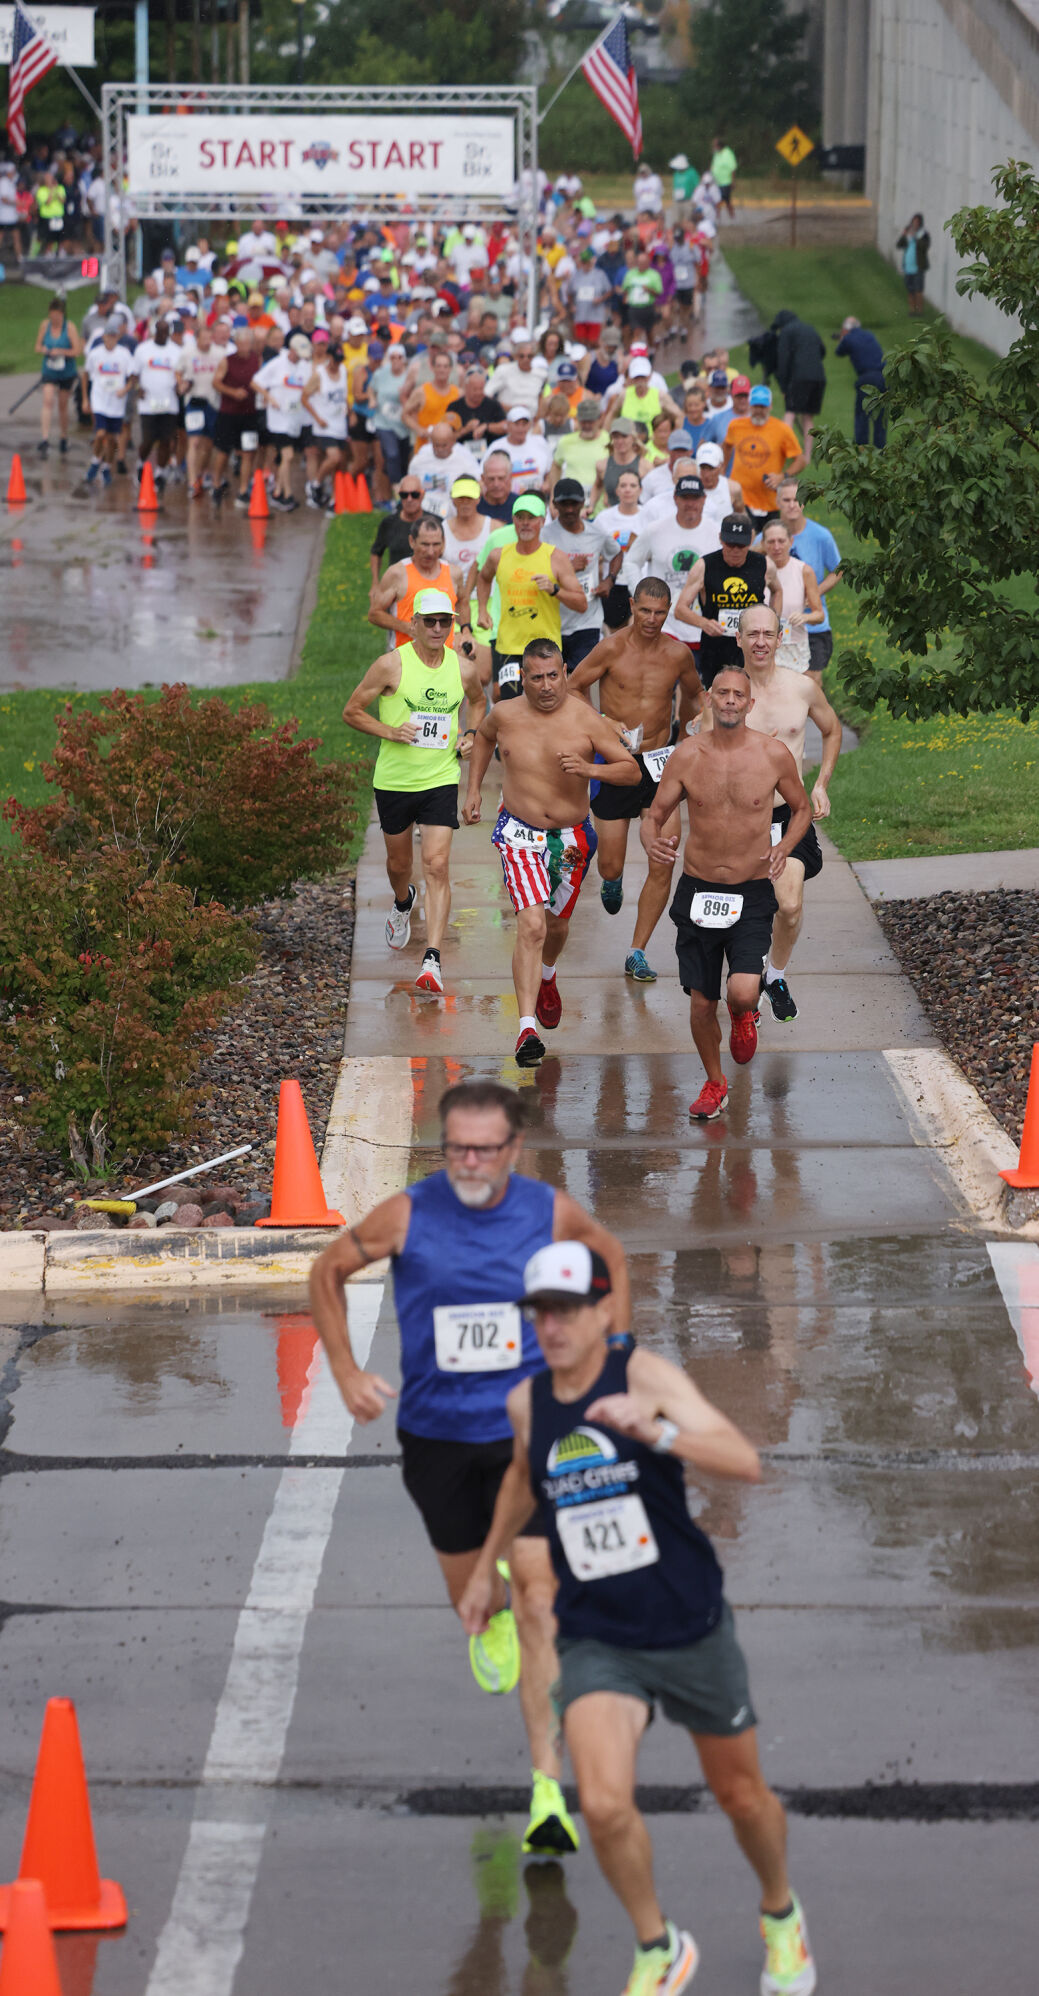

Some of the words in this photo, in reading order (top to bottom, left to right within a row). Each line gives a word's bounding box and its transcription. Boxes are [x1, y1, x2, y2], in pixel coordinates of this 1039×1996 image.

[151, 142, 177, 160] Sr.
[199, 139, 294, 169] START
[348, 140, 443, 170] START
[465, 141, 491, 161] Sr.
[150, 162, 179, 178] Bix
[462, 161, 492, 178] Bix
[711, 593, 759, 603] IOWA
[417, 705, 432, 713] RACE
[432, 706, 449, 714] TEAM
[423, 721, 438, 738] 64
[703, 899, 730, 916] 899
[457, 1321, 499, 1351] 702
[583, 1518, 627, 1556] 421
